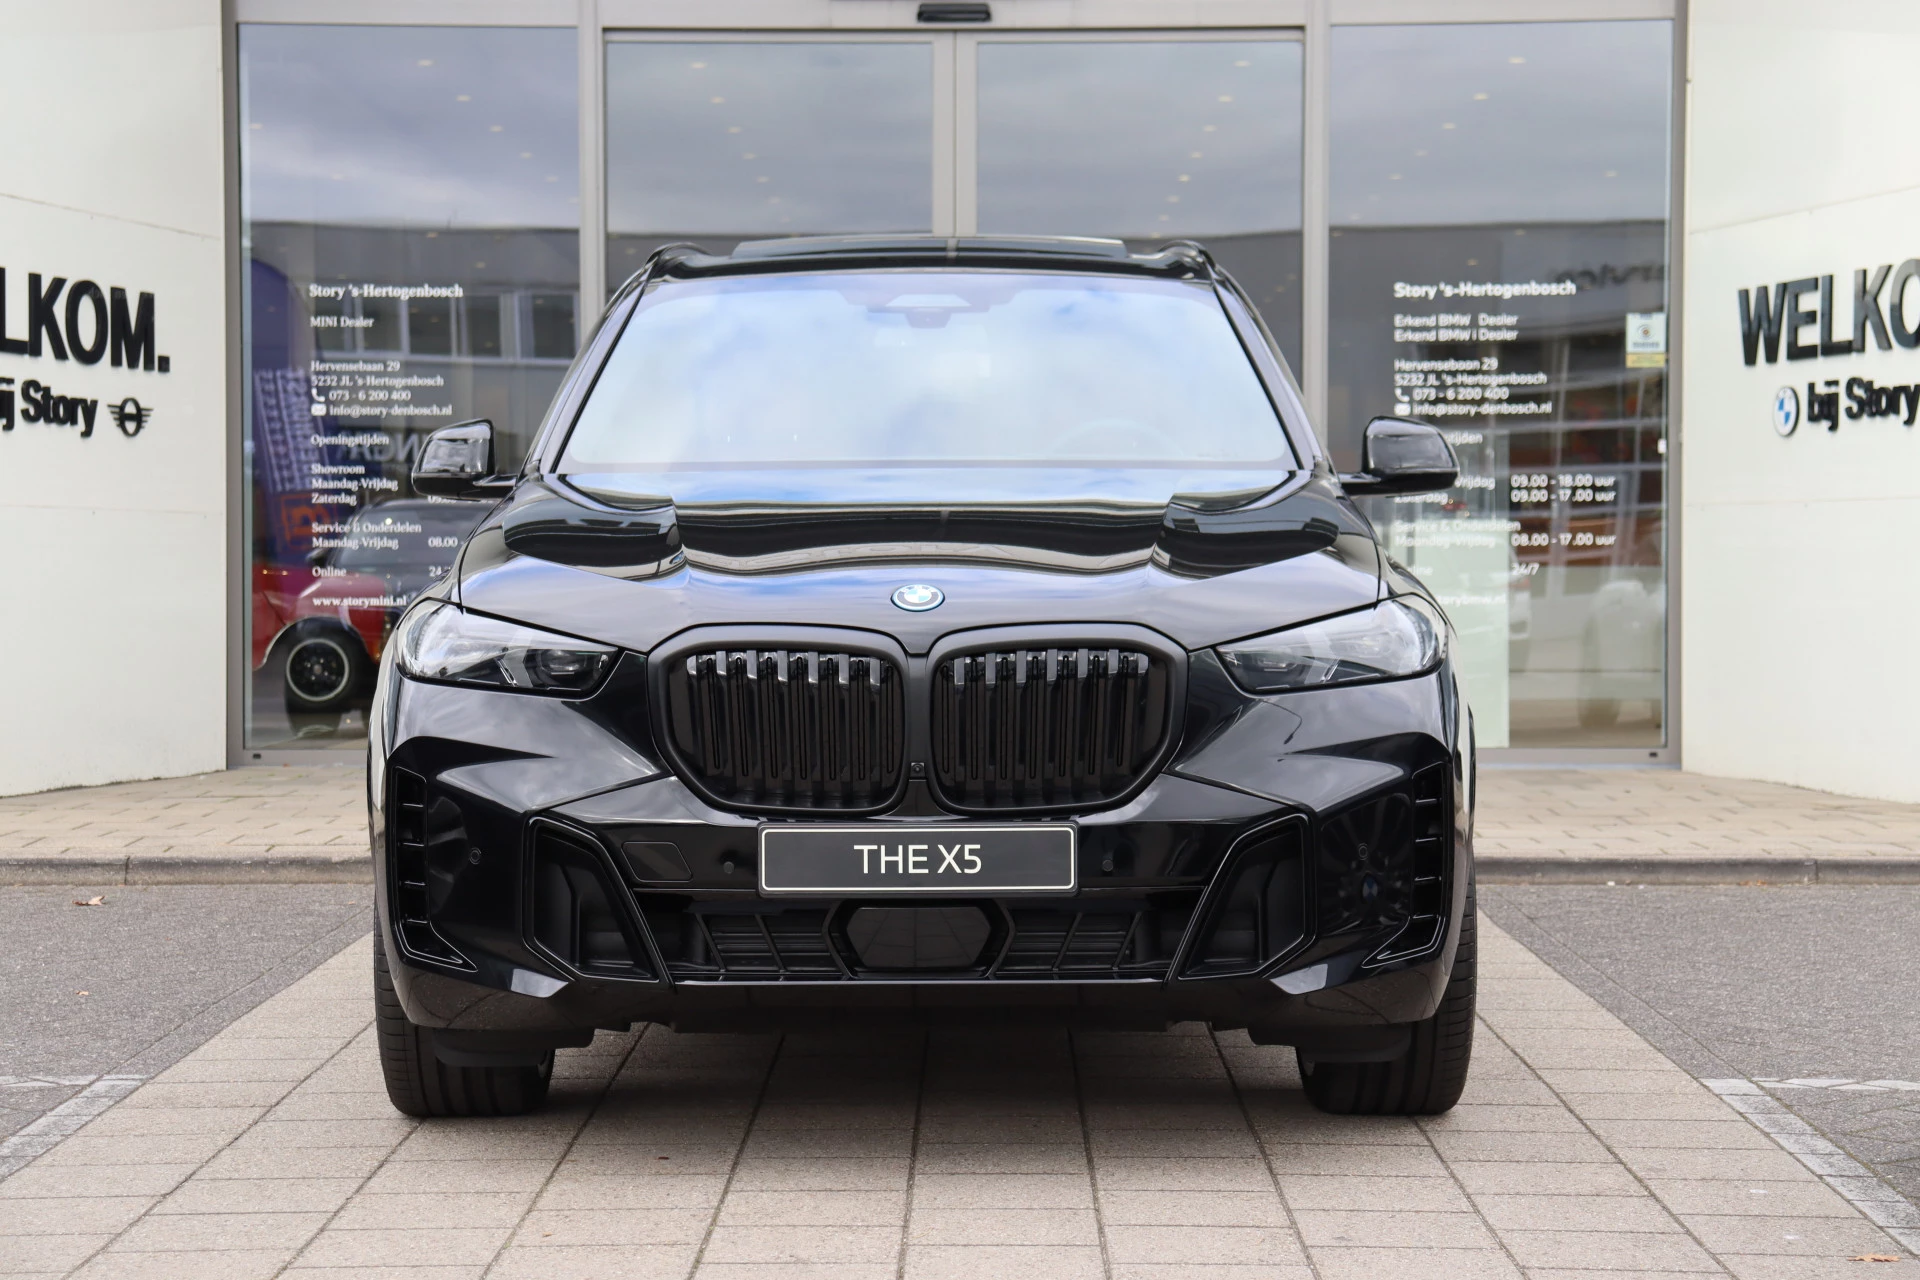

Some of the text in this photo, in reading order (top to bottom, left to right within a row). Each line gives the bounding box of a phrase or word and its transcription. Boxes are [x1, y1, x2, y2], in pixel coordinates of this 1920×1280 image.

[309, 284, 346, 300] Story
[1394, 280, 1577, 300] Story 's-Hertogenbosch
[1738, 258, 1920, 367] WELKO
[0, 266, 170, 373] LKOM.
[310, 316, 374, 327] MINI Dealer
[1394, 313, 1519, 327] Erkend BMW Dealer
[1394, 328, 1436, 342] Erkend
[1438, 328, 1471, 341] BMW
[1478, 328, 1519, 341] Dealer
[311, 361, 400, 372] Hervensebaan 29
[1394, 357, 1498, 371] Hervensebaan 29
[311, 376, 338, 386] 5232
[1394, 373, 1424, 386] 5232
[329, 390, 349, 401] 073
[358, 390, 366, 401] 6
[369, 390, 388, 401] 200
[391, 390, 411, 401] 400
[1413, 387, 1436, 400] 073
[1446, 387, 1455, 400] 6
[1459, 387, 1482, 400] 200
[1484, 387, 1509, 399] 400
[21, 379, 98, 438] Story
[1808, 377, 1920, 431] bij Story
[311, 434, 389, 447] Openingstijden
[311, 463, 365, 475] Showroom
[1511, 474, 1548, 487] 09.00
[1558, 473, 1593, 487] 18.00
[1594, 476, 1616, 487] uur
[311, 493, 357, 506] Zaterdag
[1511, 488, 1548, 502] 09.00
[1595, 491, 1616, 501] uur
[312, 522, 349, 533] Service
[363, 522, 422, 533] Onderdelen
[428, 536, 458, 548] 08.00
[1511, 533, 1549, 546] 08.00
[1595, 535, 1616, 545] uur
[312, 566, 347, 577] Online
[313, 595, 407, 608] www.storymini.nl
[853, 844, 982, 874] THE X5
